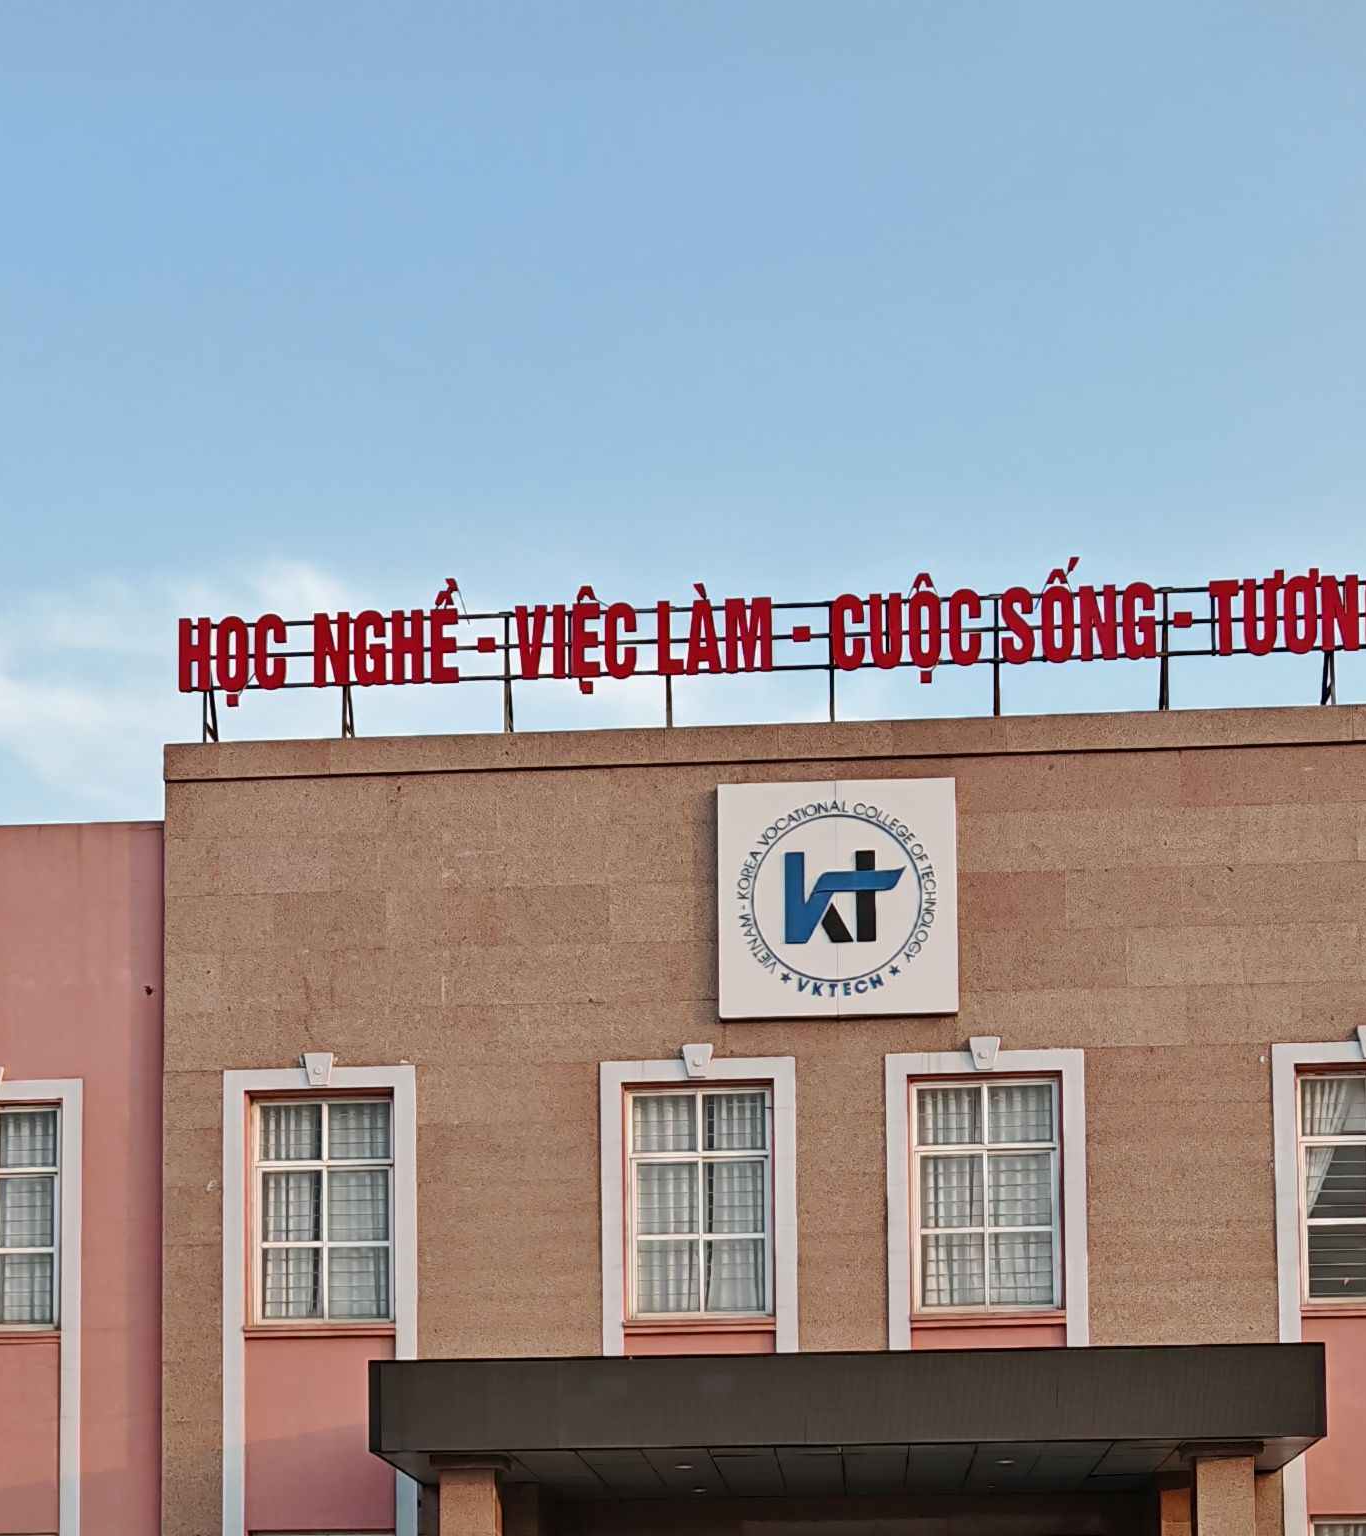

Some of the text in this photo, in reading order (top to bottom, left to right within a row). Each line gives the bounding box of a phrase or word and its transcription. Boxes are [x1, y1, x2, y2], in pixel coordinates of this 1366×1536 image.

[178, 615, 287, 705] HỌC
[313, 579, 459, 687] NGHỀ
[514, 587, 636, 693] VIỆC
[656, 584, 772, 676] LÀM
[831, 572, 982, 684] CUỘC
[1001, 556, 1158, 664] SỐNG
[757, 800, 849, 847] VOCATIONAL
[853, 803, 915, 845] COLLEGE
[736, 851, 763, 900] KOREA
[910, 844, 929, 863] OF
[903, 864, 936, 963] TECHNOLOGY
[738, 914, 778, 974] VIETNAM
[797, 974, 884, 997] VKTECH
